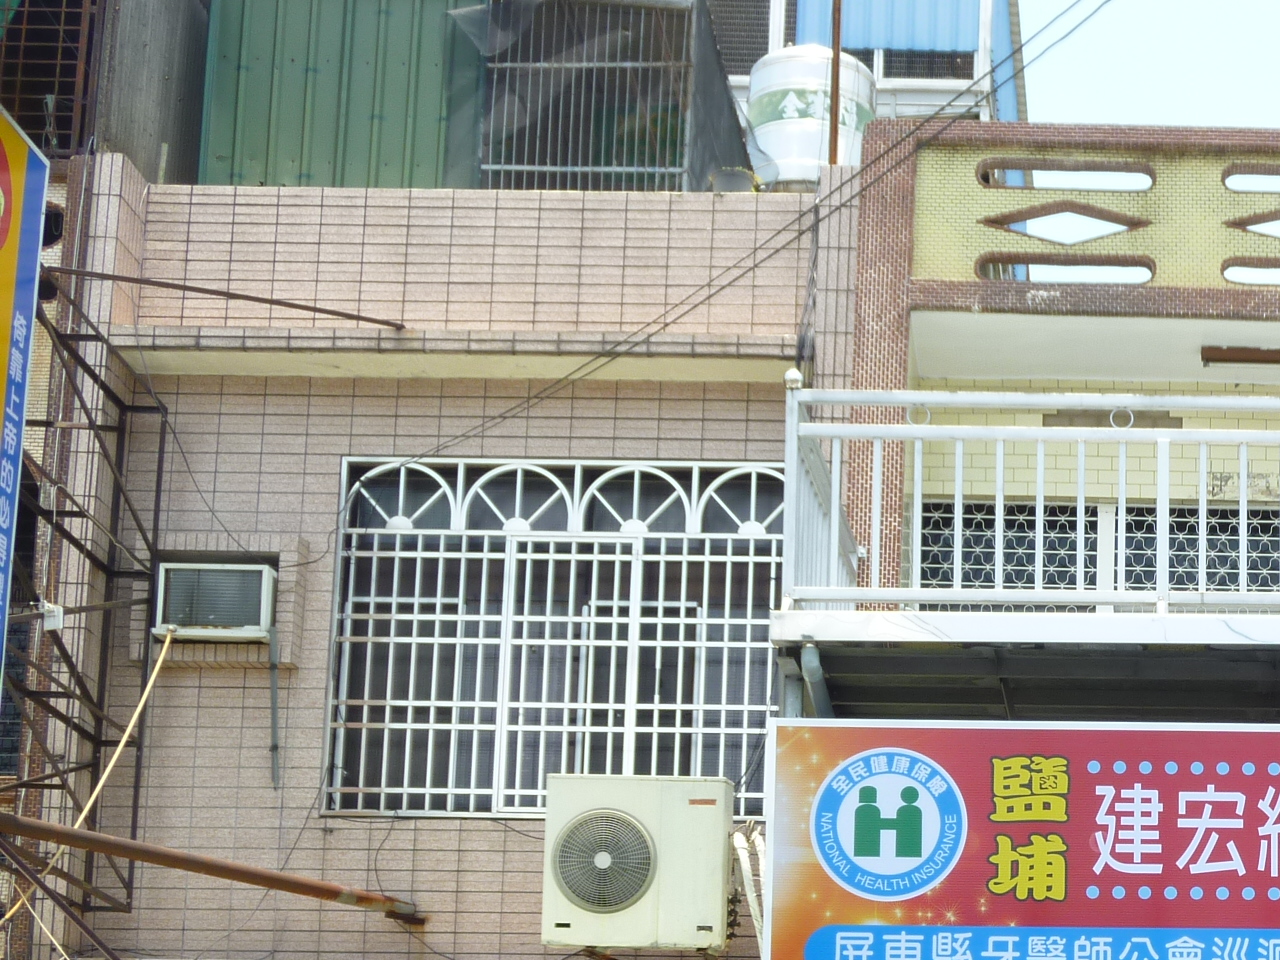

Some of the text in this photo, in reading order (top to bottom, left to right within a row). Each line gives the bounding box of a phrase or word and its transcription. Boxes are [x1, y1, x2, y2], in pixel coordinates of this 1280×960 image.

[831, 755, 948, 797] 全民健康保險
[821, 812, 957, 891] NATIONAL HEALTH INSURANCE
[988, 755, 1070, 903] 鹽埔
